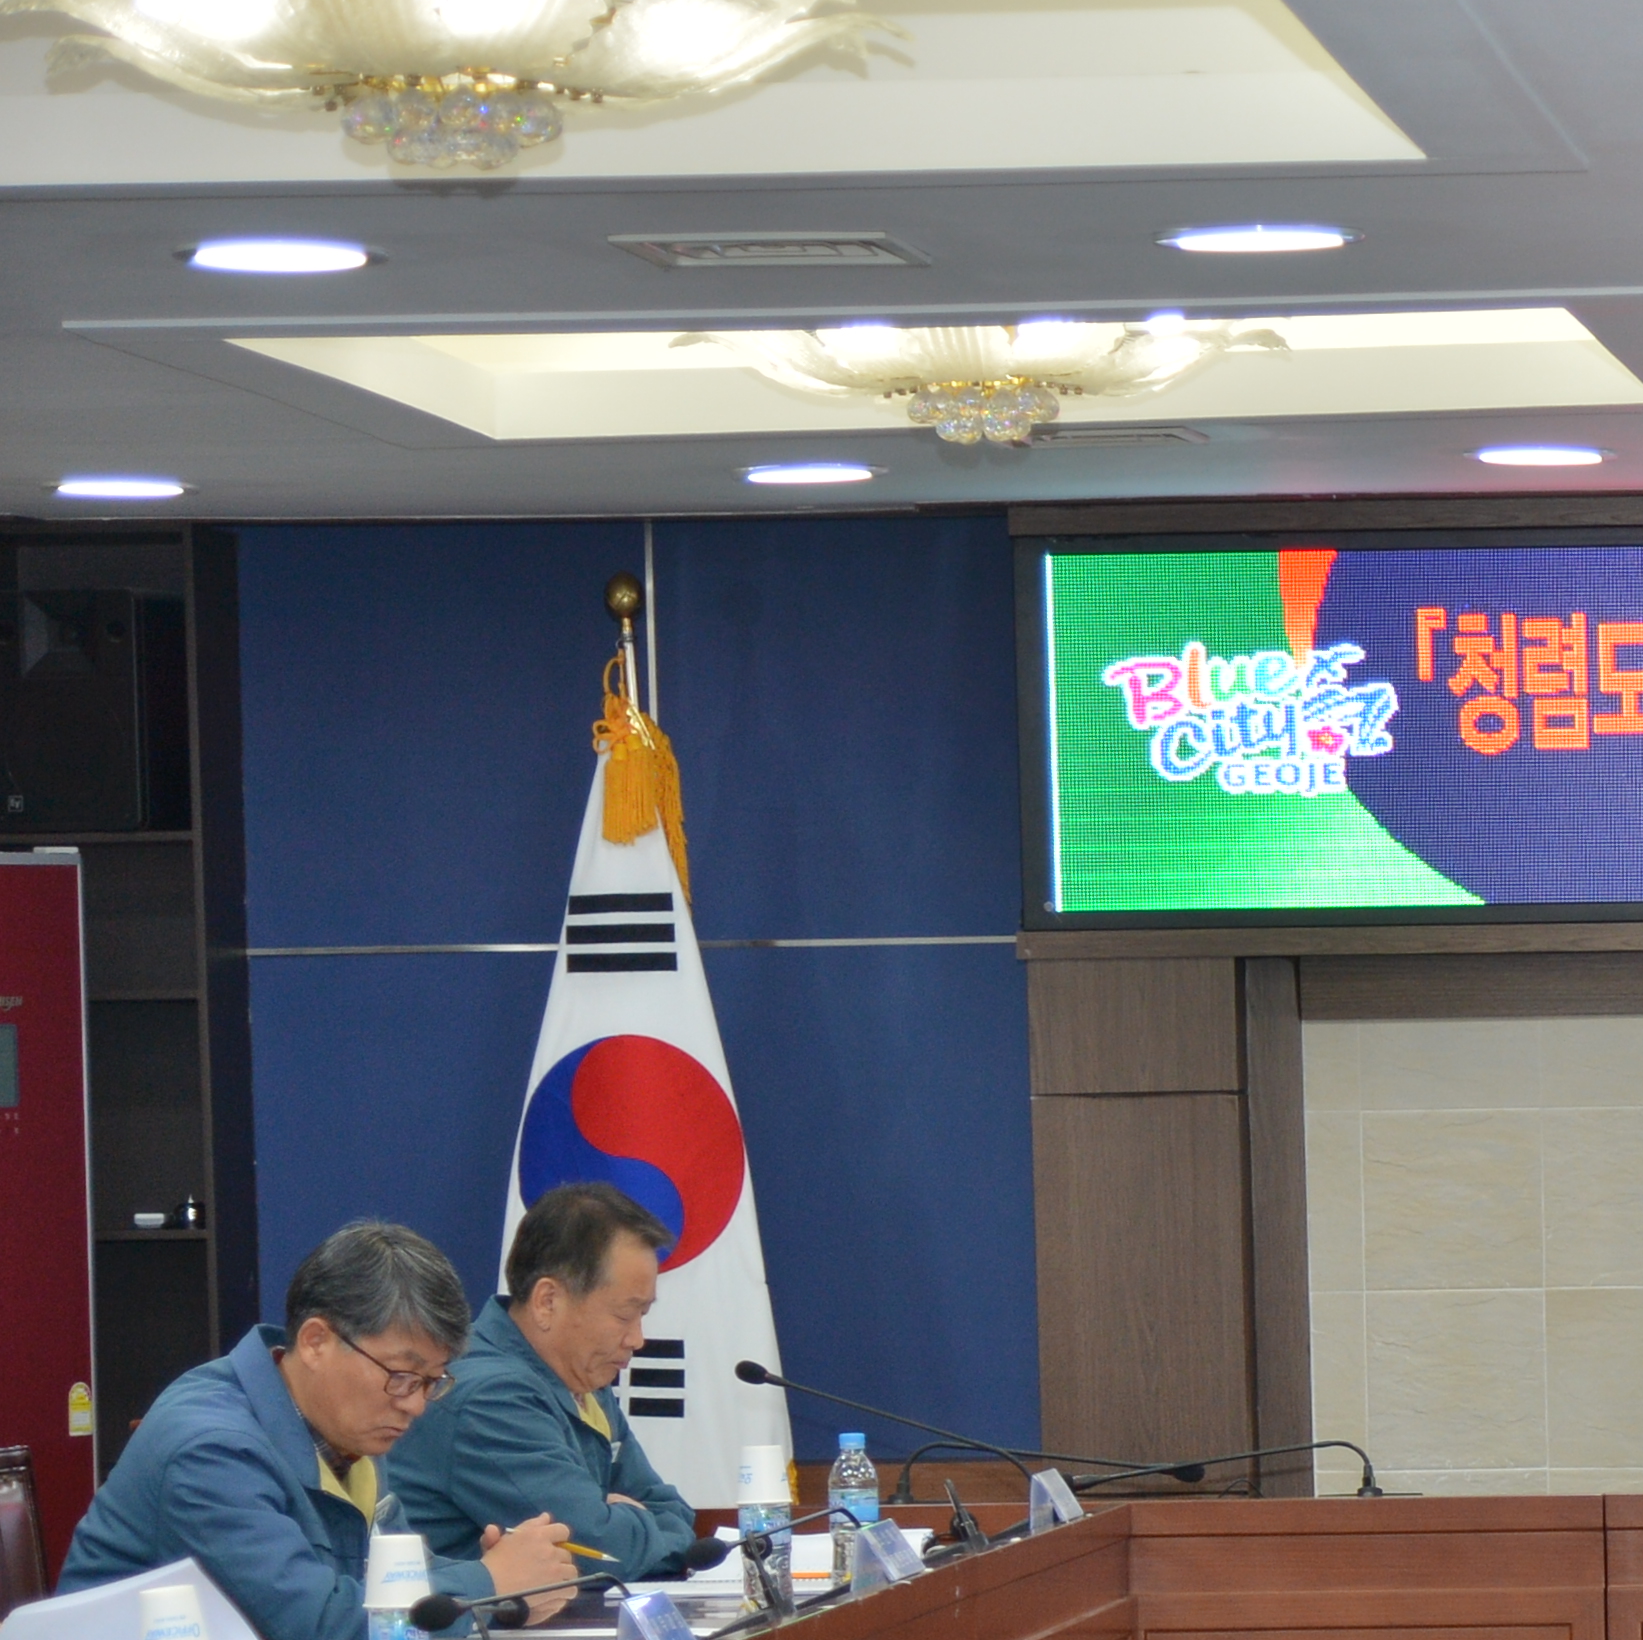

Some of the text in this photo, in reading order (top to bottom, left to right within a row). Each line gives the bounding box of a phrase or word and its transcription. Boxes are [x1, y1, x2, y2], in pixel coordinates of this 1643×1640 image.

[1107, 646, 1298, 726] Blue
[1158, 698, 1299, 777] City
[1222, 760, 1343, 794] GEOJE
